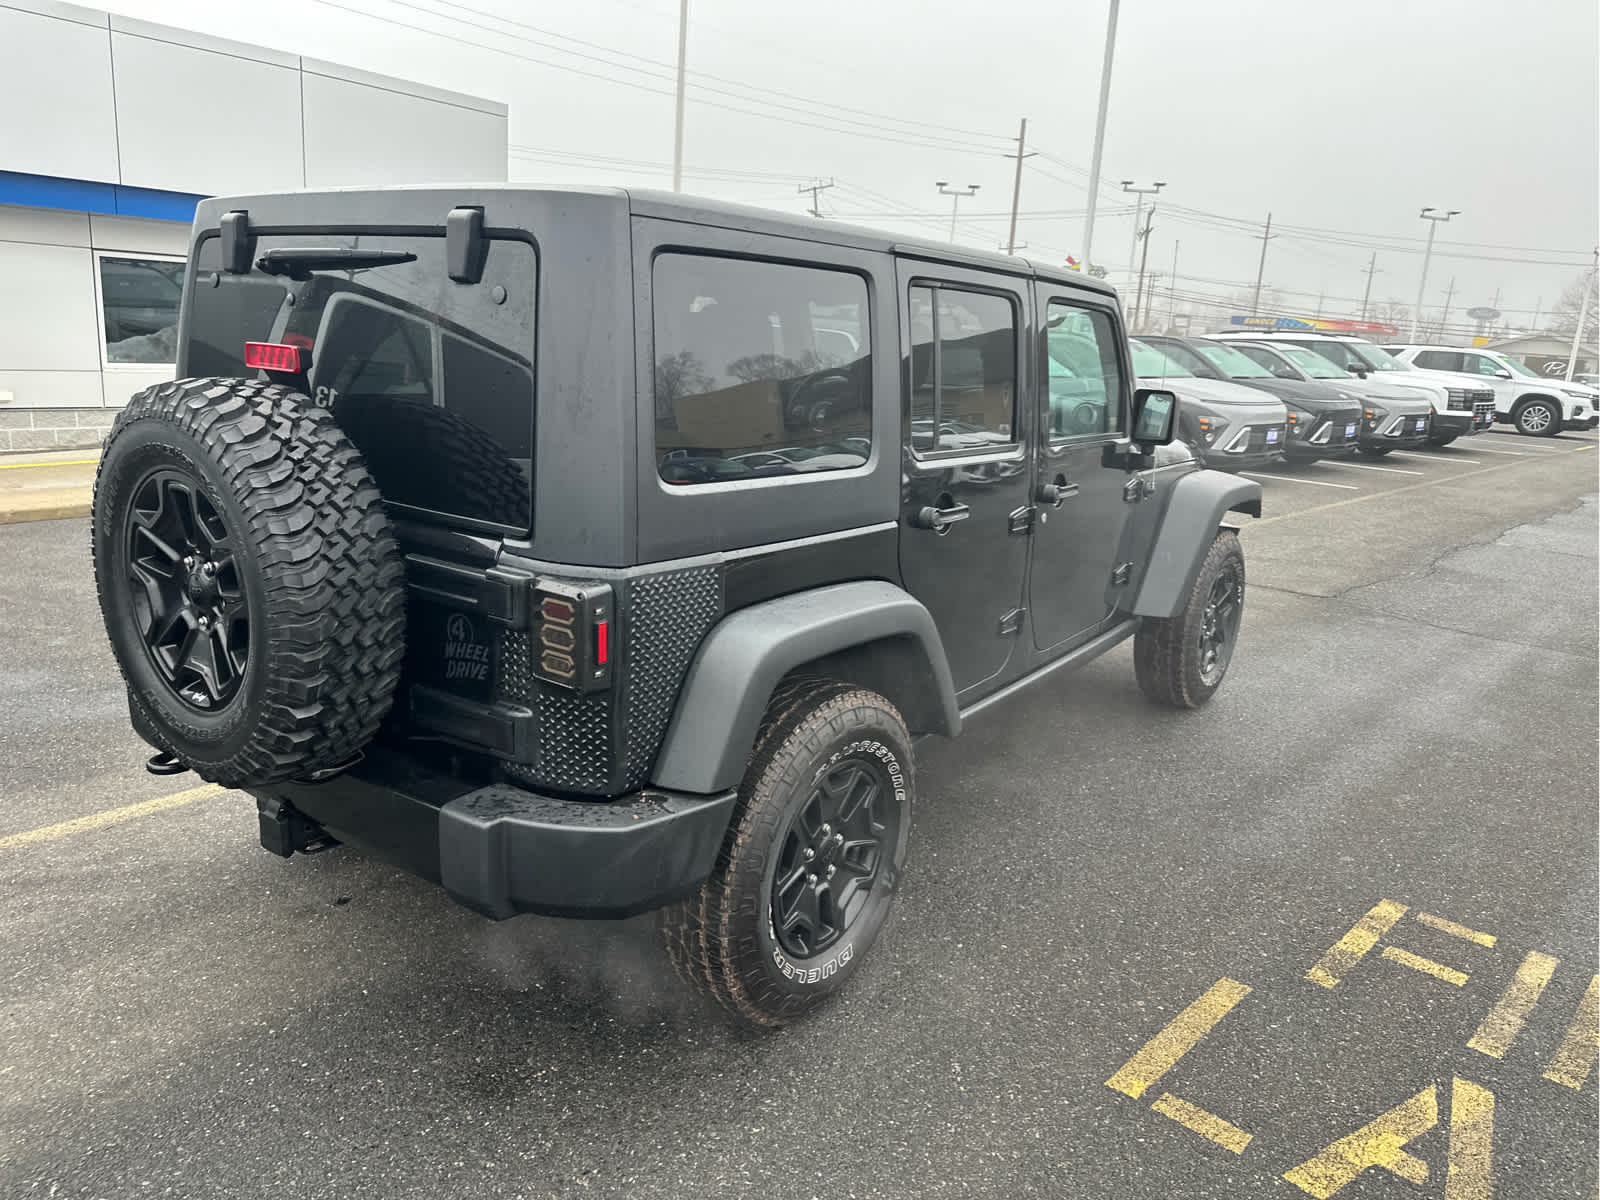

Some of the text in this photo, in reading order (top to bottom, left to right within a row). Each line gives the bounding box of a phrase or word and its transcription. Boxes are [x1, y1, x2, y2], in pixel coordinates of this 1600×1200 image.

[445, 640, 490, 662] WHEEL
[445, 659, 490, 681] DRIVE
[773, 943, 854, 985] DUELER
